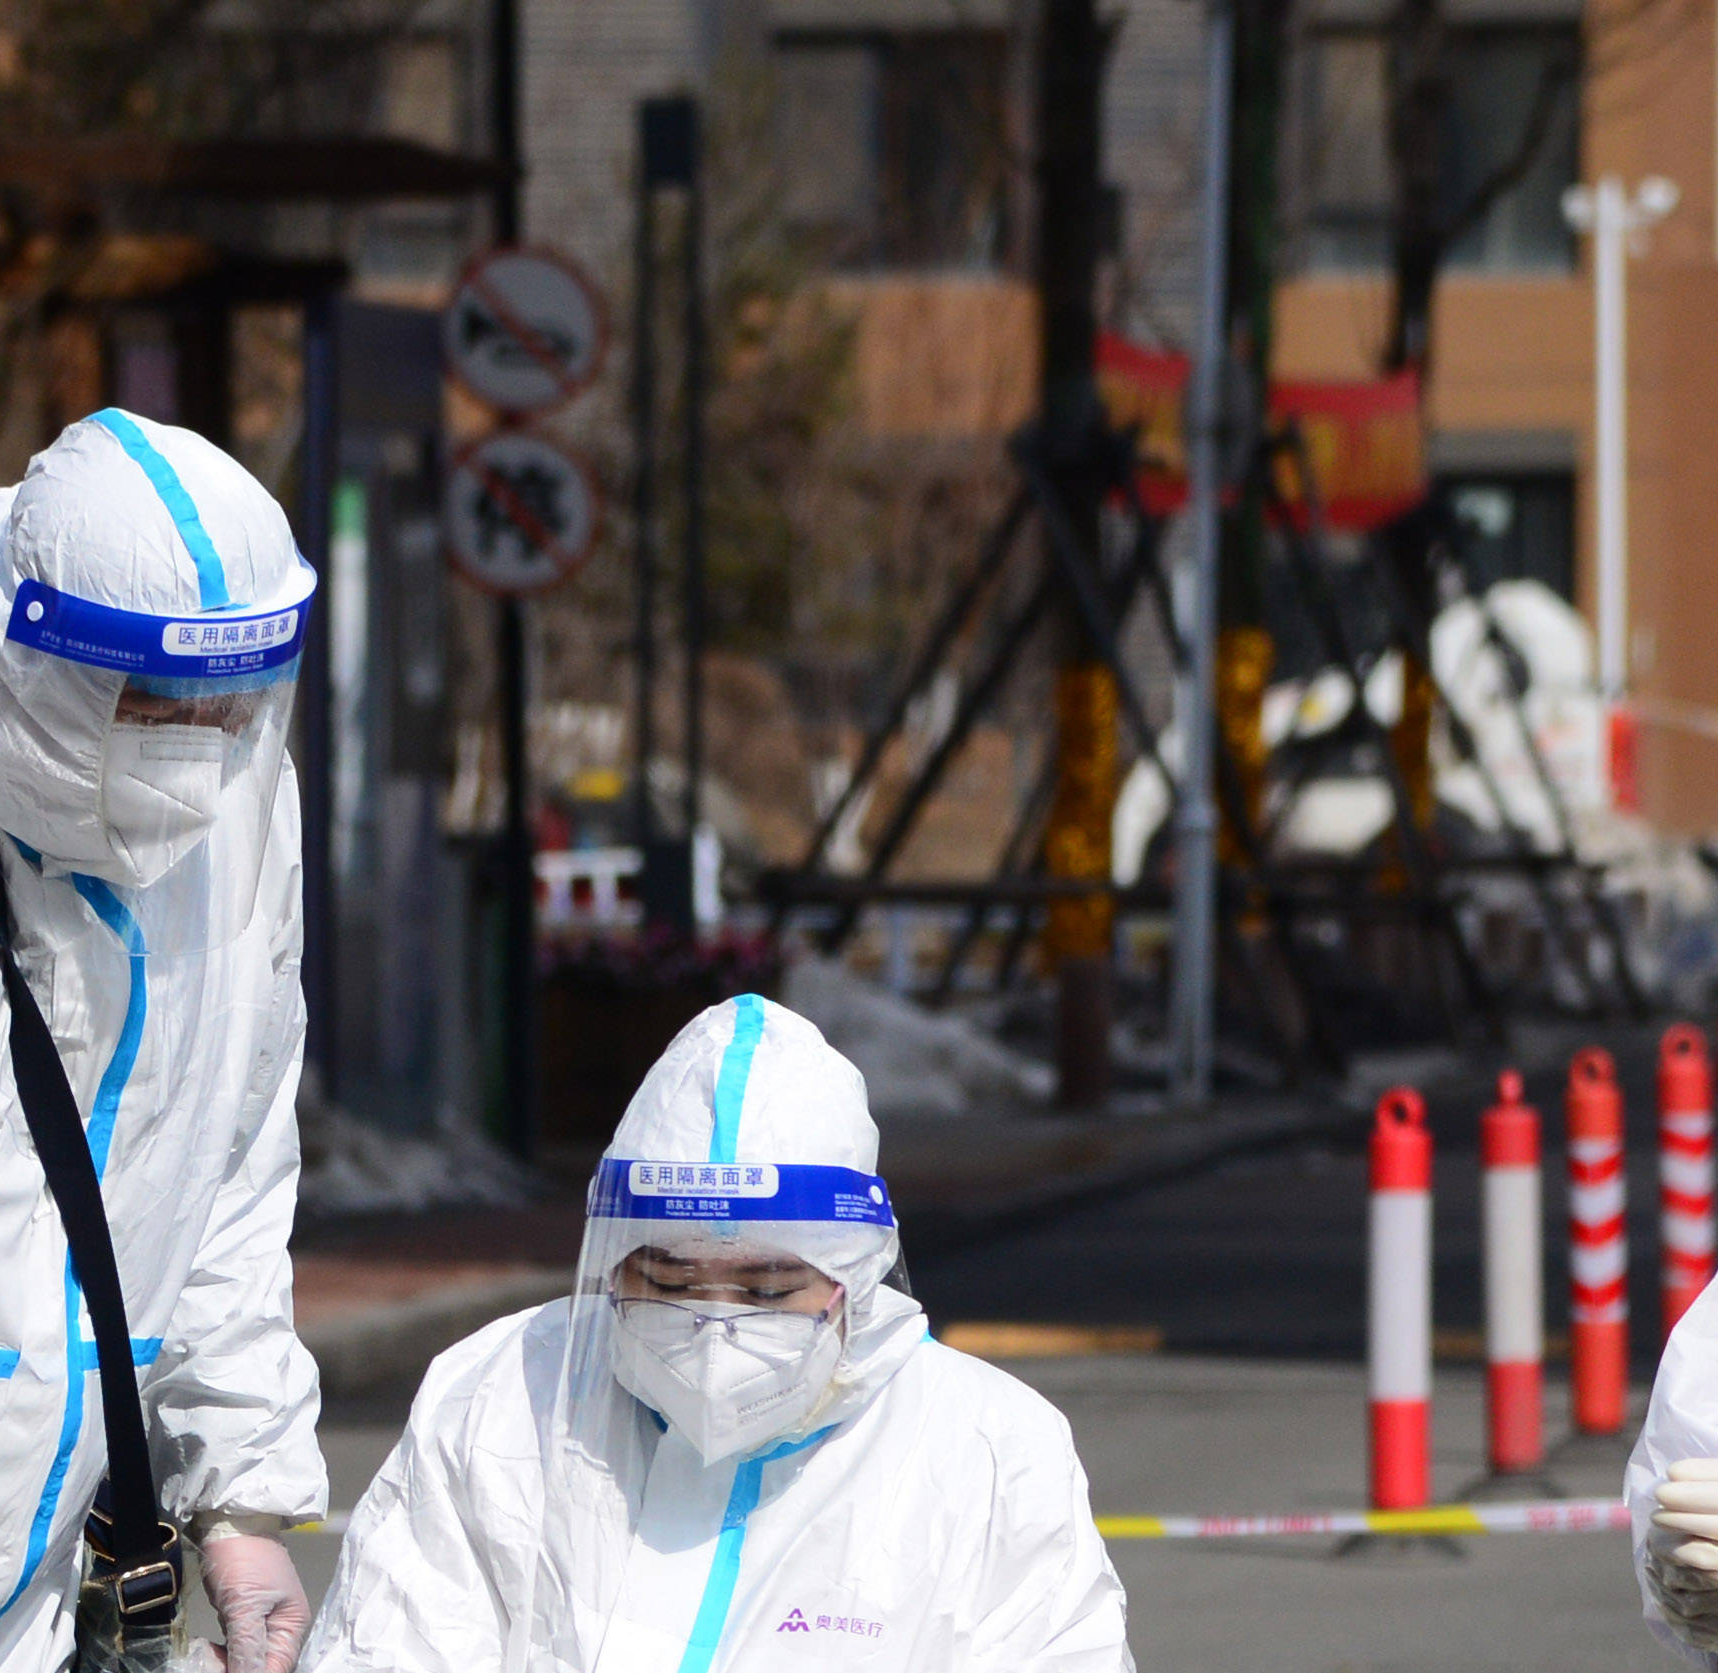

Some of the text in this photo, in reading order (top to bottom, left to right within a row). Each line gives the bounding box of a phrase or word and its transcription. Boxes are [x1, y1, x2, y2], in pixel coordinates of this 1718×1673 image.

[178, 615, 291, 646] 医用隔离面罩
[639, 1165, 764, 1187] 医用隔离面罩
[657, 1186, 682, 1194] Medical
[816, 1614, 884, 1638] 奥美医疗
